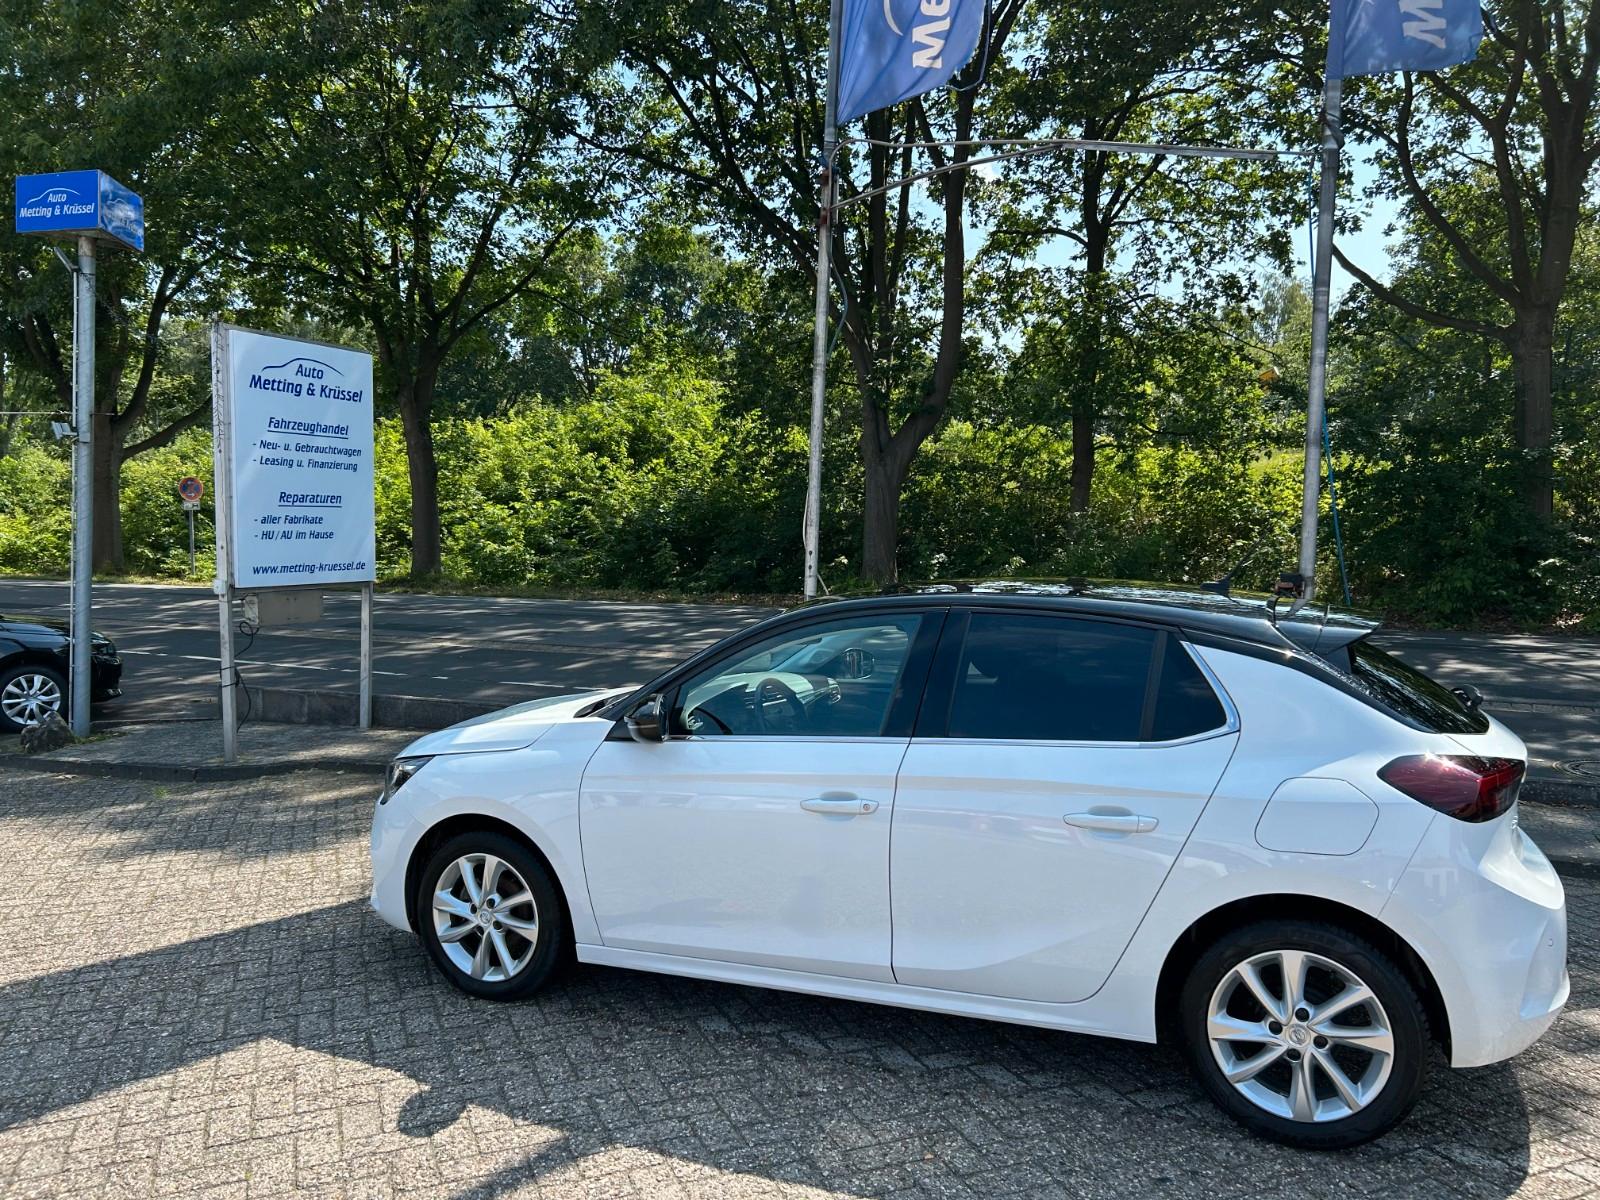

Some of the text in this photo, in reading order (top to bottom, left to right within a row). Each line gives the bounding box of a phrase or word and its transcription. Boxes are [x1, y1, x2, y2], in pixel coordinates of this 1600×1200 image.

[47, 193, 67, 203] Auto
[19, 202, 95, 218] Metting & Krüssel
[295, 363, 324, 380] Auto
[249, 374, 363, 403] Metting & Krüssel
[268, 416, 349, 436] Fahrzeughandel
[259, 439, 281, 451] Neu-
[283, 443, 292, 451] u.
[294, 443, 362, 457] Gebrauchtwagen
[259, 455, 294, 469] Leasing
[296, 460, 305, 468] u.
[307, 458, 358, 472] Finanzierung
[278, 491, 342, 506] Reparaturen
[260, 515, 281, 525] aller
[283, 514, 324, 525] Fabrikate
[295, 530, 307, 540] im
[308, 530, 335, 540] Hause
[252, 561, 366, 575] www.metting-kruessel.de
